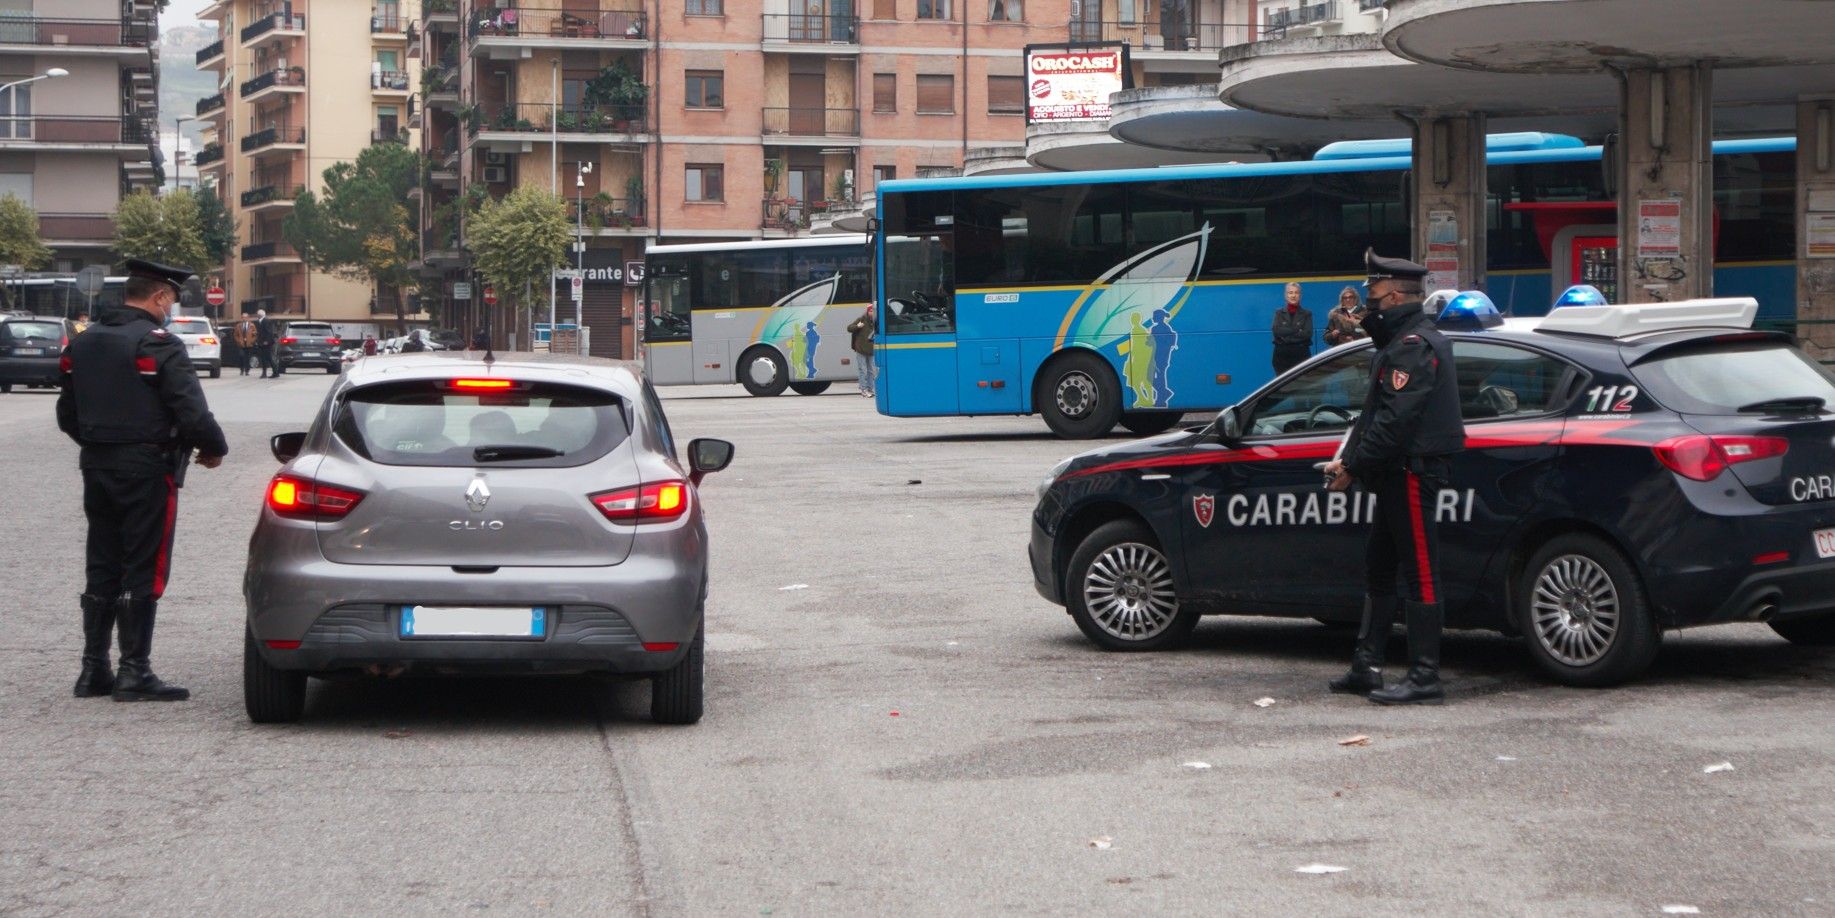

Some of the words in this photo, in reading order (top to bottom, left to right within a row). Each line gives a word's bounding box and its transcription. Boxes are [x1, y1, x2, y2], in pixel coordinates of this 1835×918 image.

[1032, 56, 1115, 71] OROCASH
[1033, 105, 1075, 113] ACQUISTO
[1586, 384, 1638, 412] 112
[449, 520, 504, 530] CLIO
